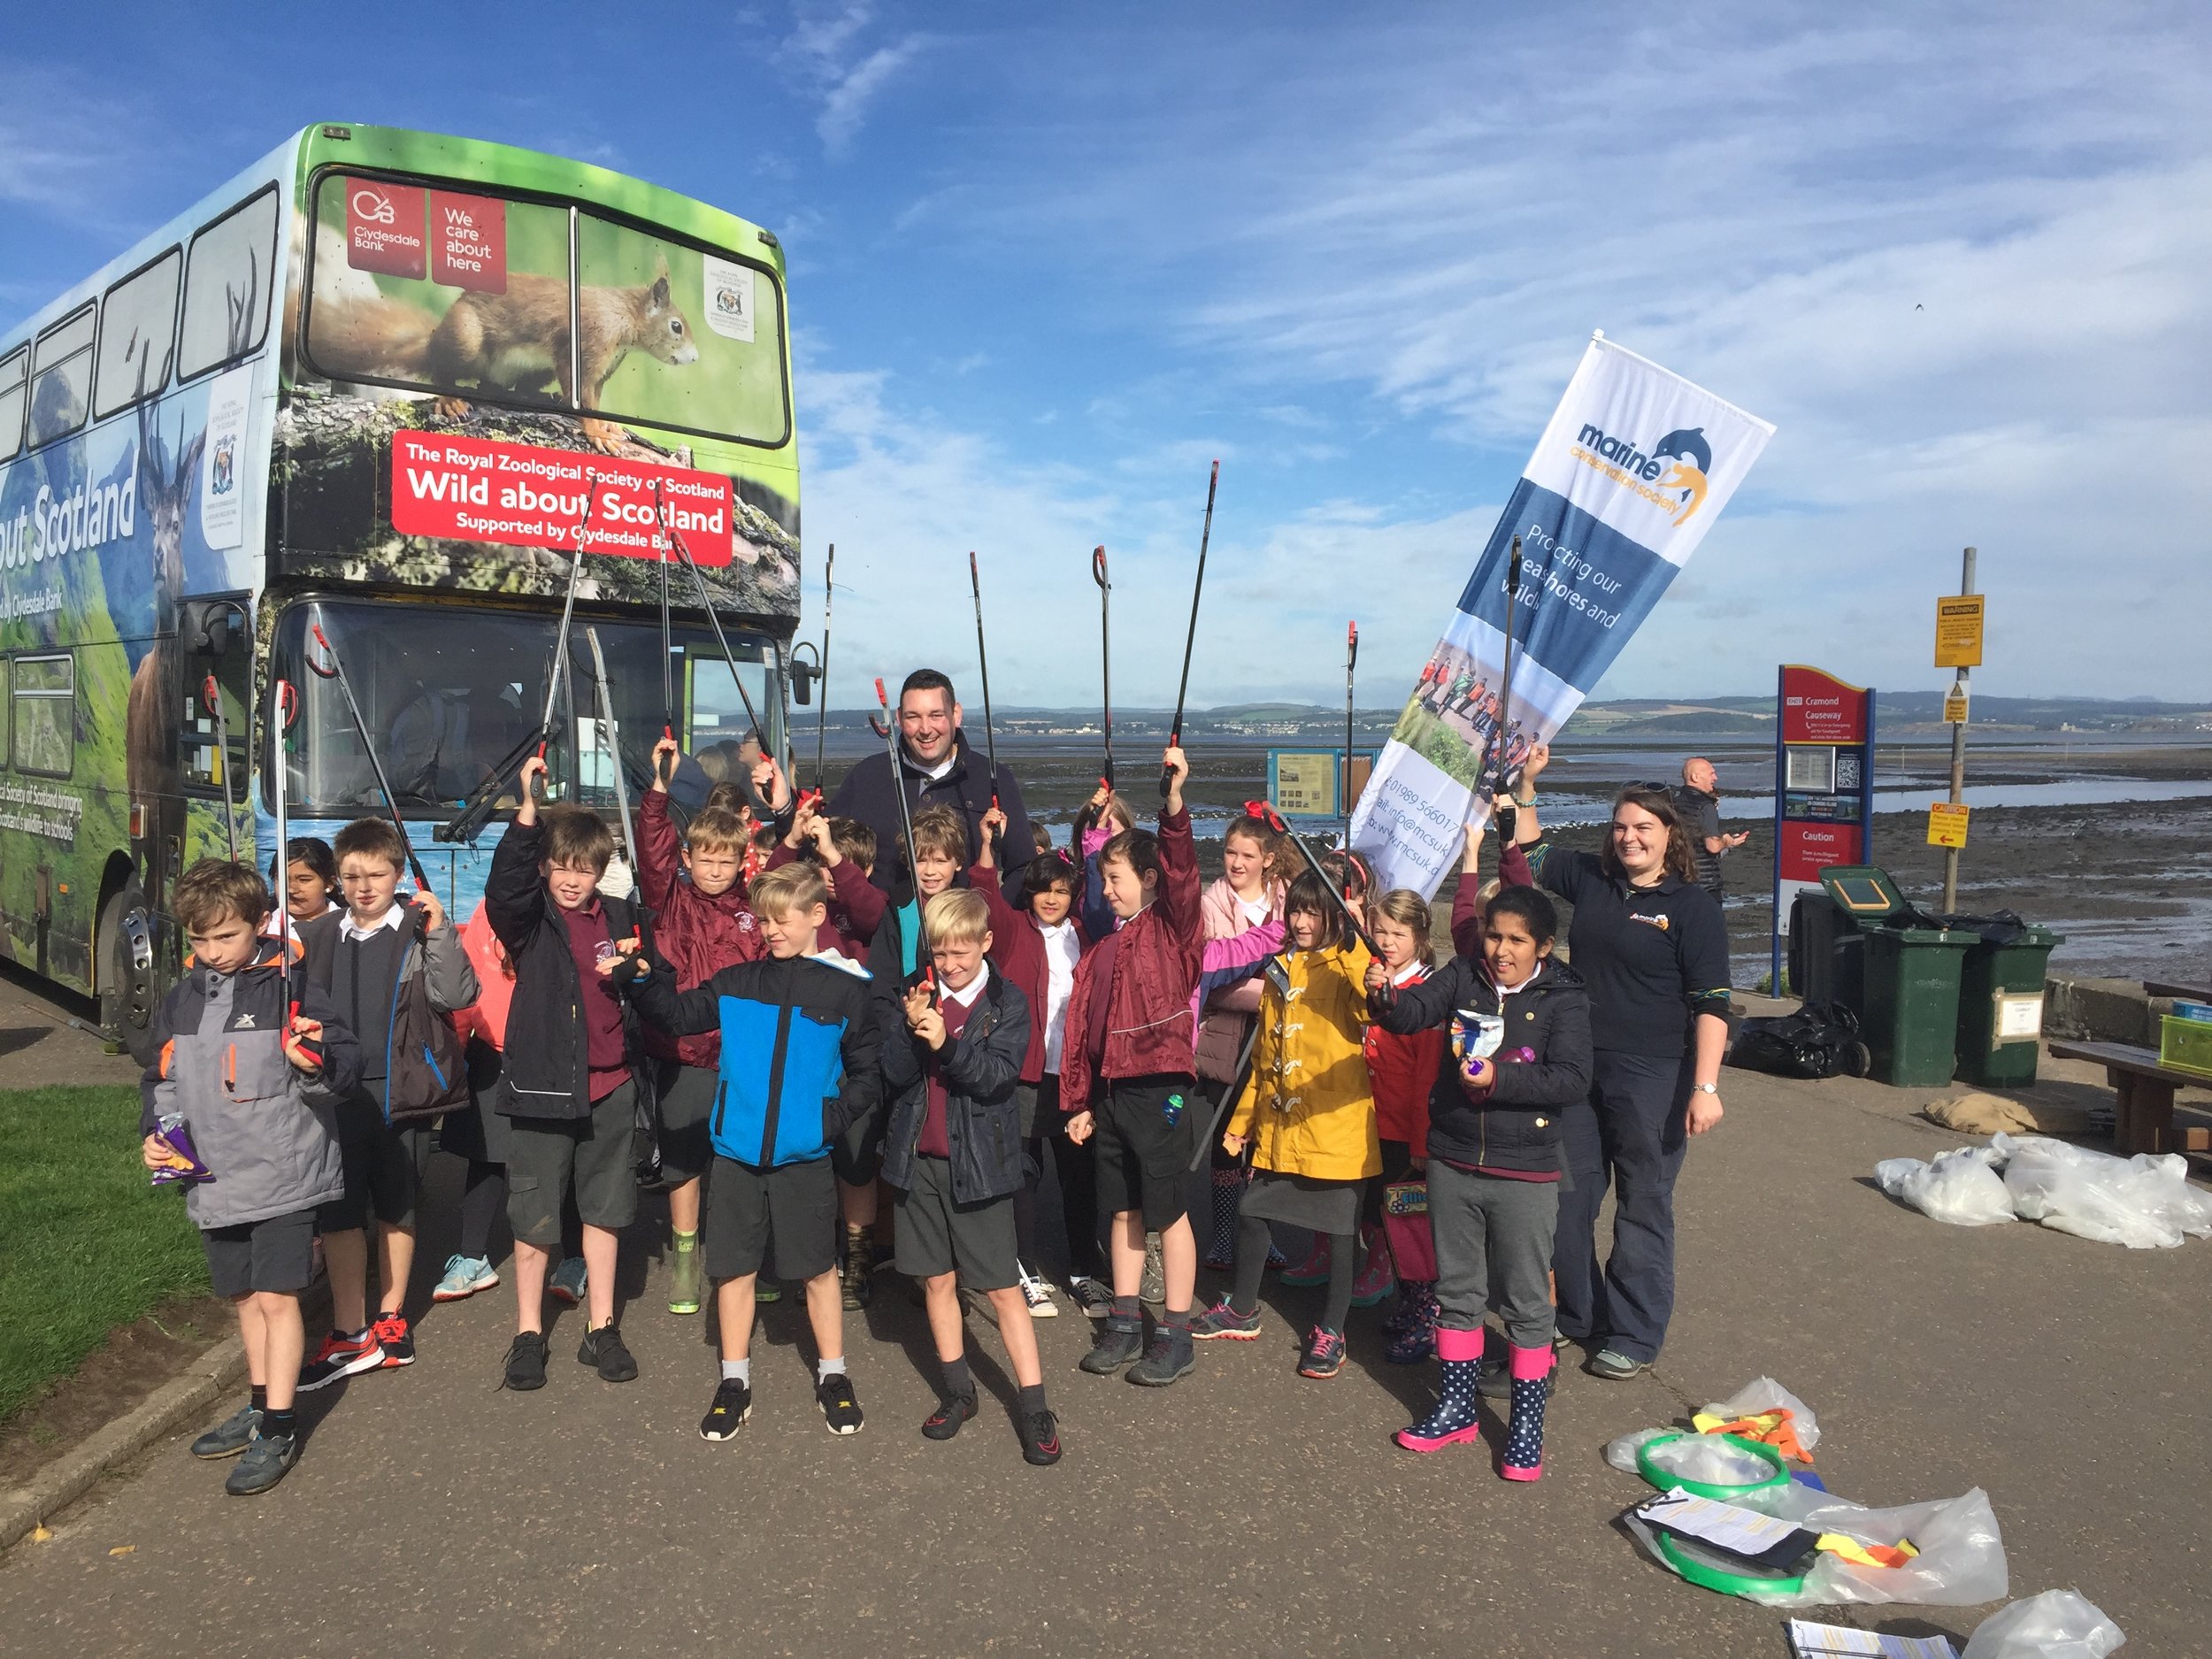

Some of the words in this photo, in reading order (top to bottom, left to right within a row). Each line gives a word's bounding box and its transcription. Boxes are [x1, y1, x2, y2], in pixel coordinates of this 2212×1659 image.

[444, 207, 472, 227] We
[354, 226, 420, 248] Clydesdale
[355, 236, 385, 252] Bank
[446, 227, 480, 242] care
[446, 240, 493, 259] about
[447, 253, 481, 273] here
[1577, 423, 1662, 481] marine
[405, 442, 442, 463] The
[446, 448, 494, 470] Royal
[497, 454, 581, 480] Zoological
[586, 466, 642, 488] Society
[665, 478, 726, 500] Scotland
[1571, 446, 1638, 490] conservation
[1637, 480, 1682, 516] society
[33, 449, 140, 562] Scotland
[406, 467, 488, 505] Wild
[500, 481, 593, 517] about
[602, 492, 724, 534] Scotland
[457, 512, 542, 536] Supported
[547, 520, 566, 541] by
[571, 525, 648, 548] Cydesdale
[1593, 571, 1622, 595] our
[45, 587, 63, 611] Bank
[1943, 605, 1978, 614] WARNING
[1586, 603, 1621, 629] and
[1805, 696, 1839, 706] Cramond
[1805, 710, 1842, 721] Causeway
[34, 785, 58, 809] Scotland
[58, 788, 83, 819] bringing
[1390, 780, 1419, 804] 01989
[1417, 801, 1460, 833] 566017
[1932, 804, 1967, 814] CAUTION
[43, 818, 51, 836] to
[51, 818, 73, 841] schools
[1802, 831, 1835, 842] Caution
